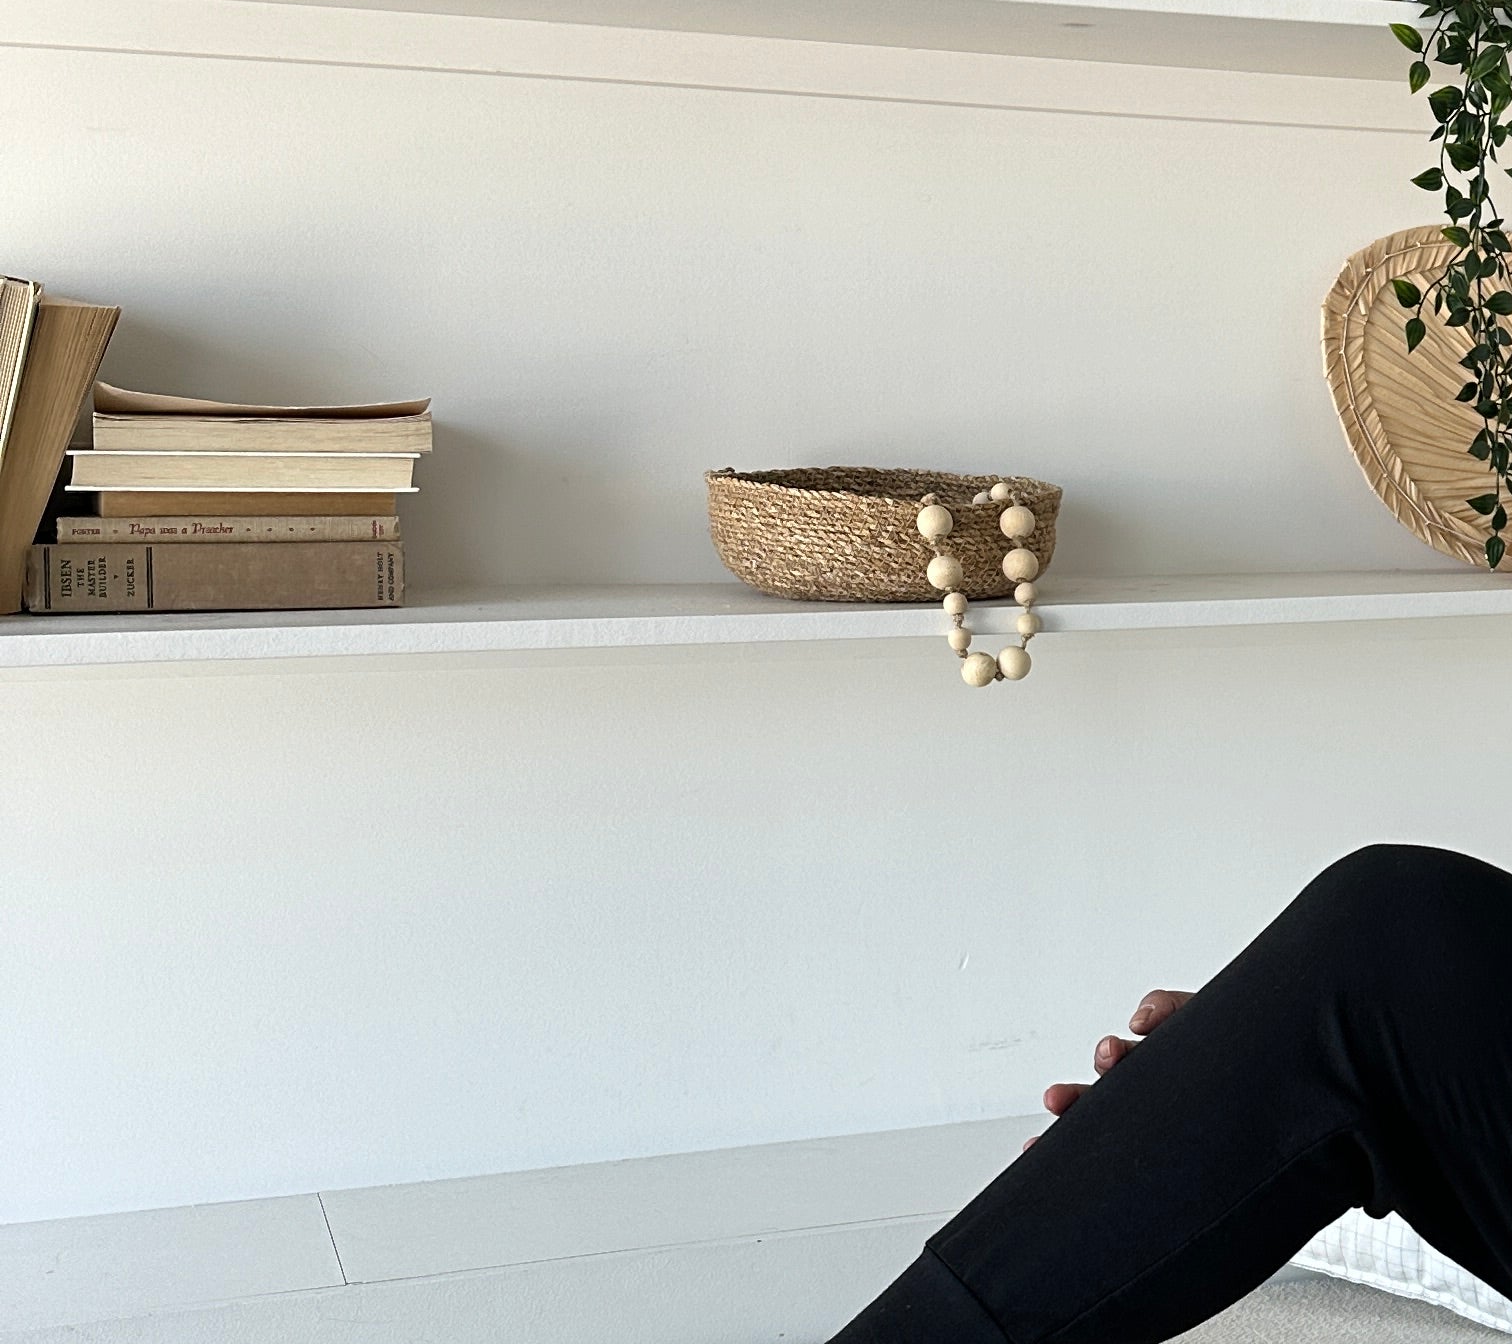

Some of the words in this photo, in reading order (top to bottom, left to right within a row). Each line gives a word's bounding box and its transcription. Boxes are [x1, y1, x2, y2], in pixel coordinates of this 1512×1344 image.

[128, 523, 156, 537] Papa
[159, 527, 178, 535] was
[181, 527, 188, 535] a
[191, 522, 234, 535] Preacher
[60, 559, 73, 598] IBSEN
[76, 568, 85, 588] THE
[87, 560, 96, 596] MASTER
[98, 556, 107, 598] BUILDER
[126, 558, 136, 597] ZUCKER
[387, 552, 395, 585] COMPANY
